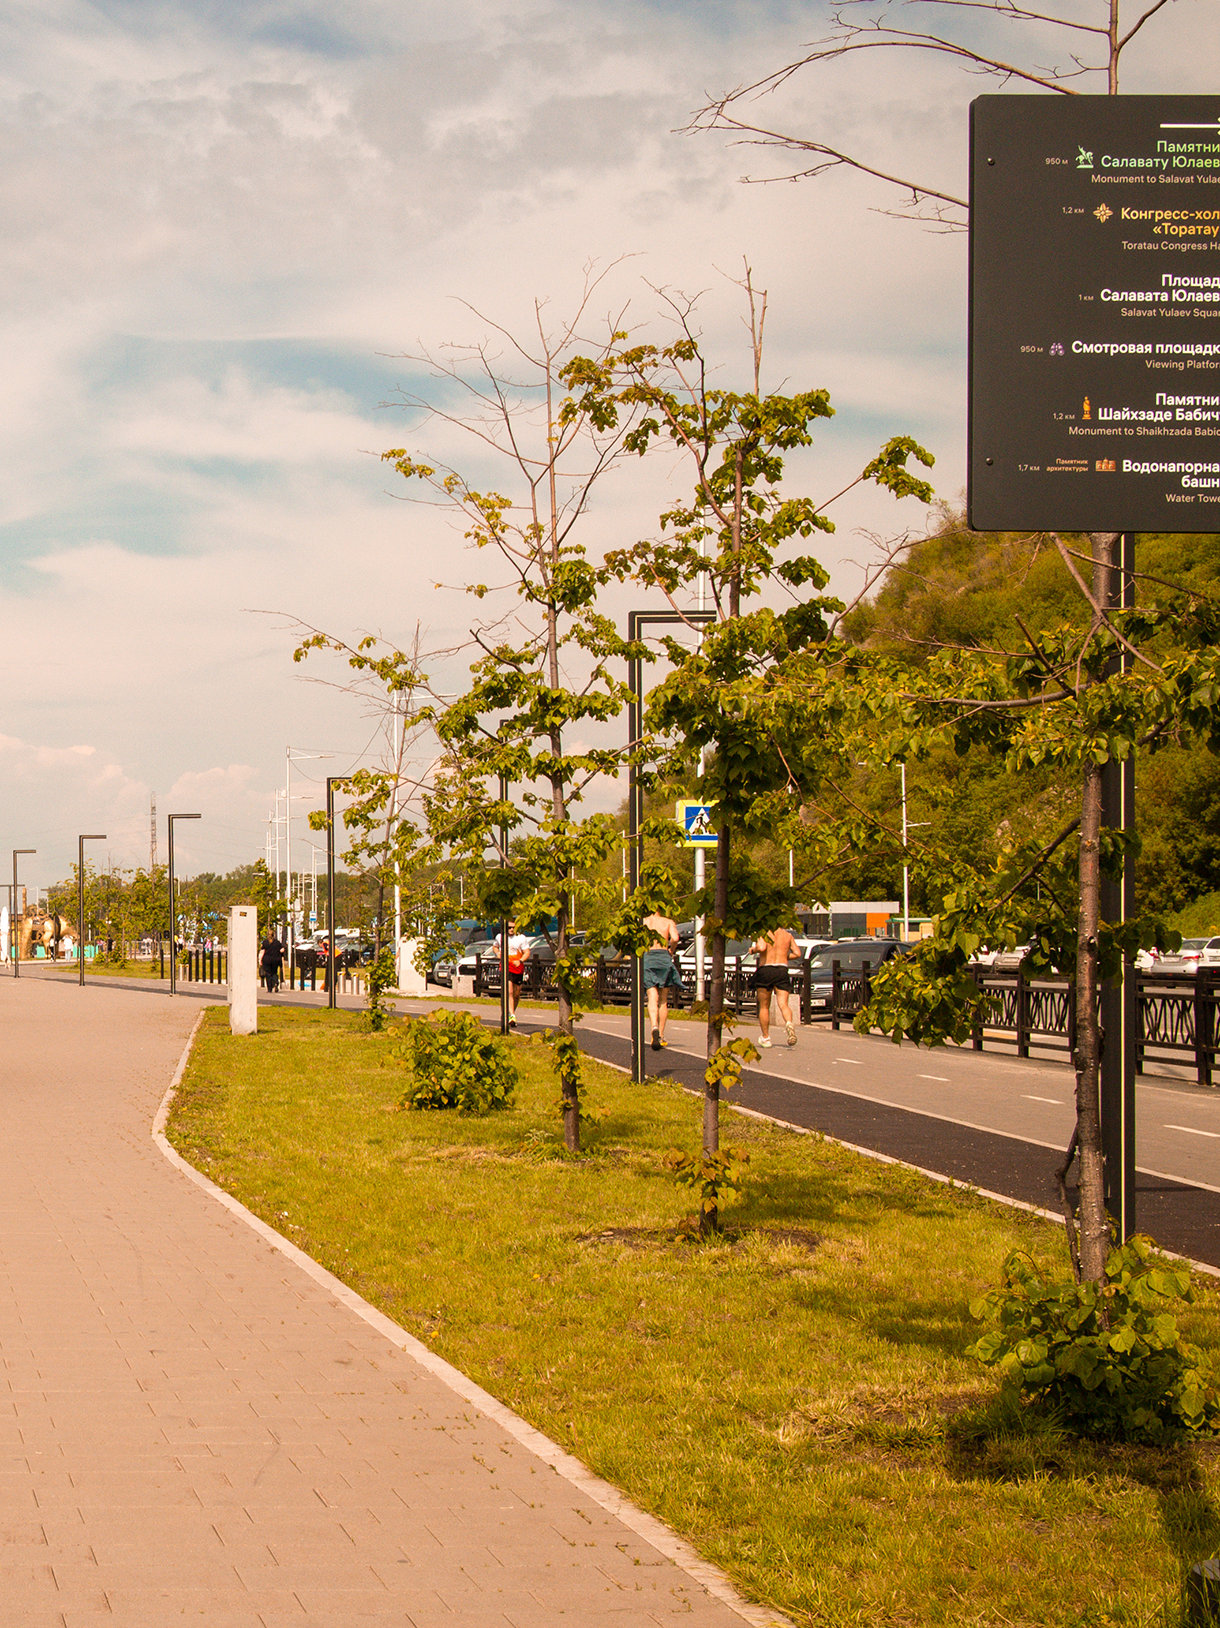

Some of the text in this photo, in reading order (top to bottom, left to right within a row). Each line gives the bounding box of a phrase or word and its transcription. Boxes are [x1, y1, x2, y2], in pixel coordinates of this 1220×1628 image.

[1045, 157, 1061, 165] 950
[1100, 155, 1170, 170] Салавату
[1091, 174, 1145, 184] Monument
[1146, 175, 1157, 184] to
[1158, 174, 1195, 184] Salavat
[1062, 206, 1073, 215] 1,2
[1121, 240, 1159, 250] Toratau
[1160, 240, 1208, 253] Congress
[1100, 288, 1169, 302] Салавата
[1120, 307, 1157, 317] Salavat
[1158, 307, 1192, 317] Yulaev
[1020, 345, 1037, 353] 950
[1071, 341, 1153, 356] Смотровая
[1145, 359, 1220, 371] Viewing Platfor
[1155, 392, 1220, 406] Памятни
[1053, 412, 1064, 421] 1,2
[1098, 407, 1220, 422] Шайхзаде Бабич
[1068, 426, 1123, 436] Monument
[1123, 427, 1135, 436] to
[1136, 426, 1193, 436] Shaikhzada
[1055, 457, 1089, 465] Памятник
[1018, 464, 1029, 472] 1,7
[1165, 493, 1196, 503] Water
